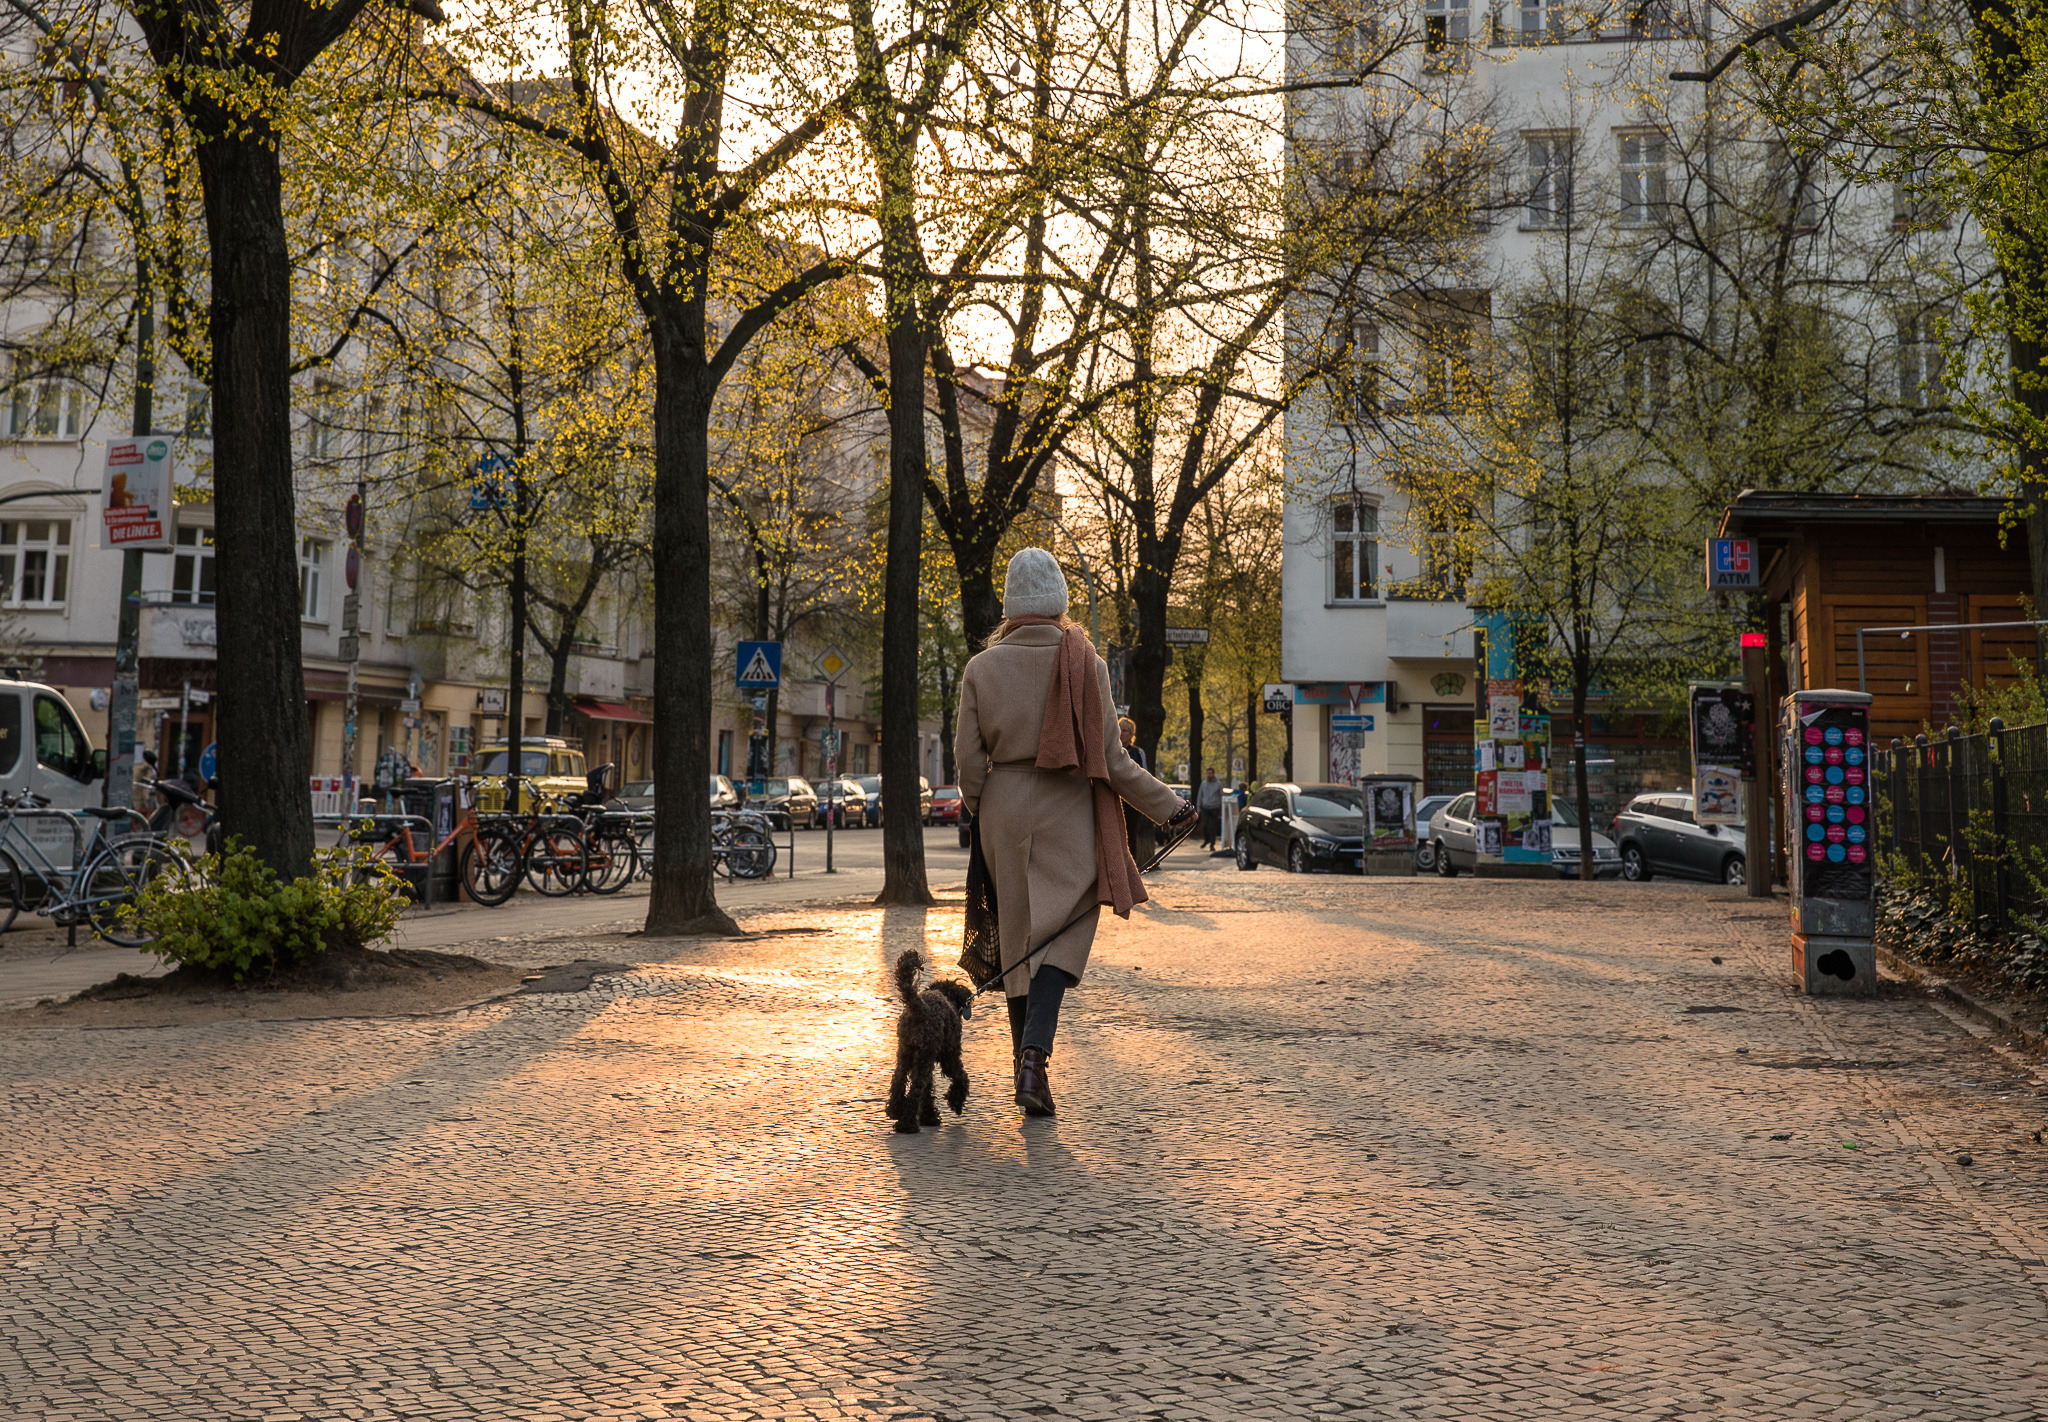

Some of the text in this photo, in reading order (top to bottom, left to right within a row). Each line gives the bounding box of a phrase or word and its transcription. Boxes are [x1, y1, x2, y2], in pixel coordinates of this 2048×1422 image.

[112, 527, 126, 540] DIE
[1717, 573, 1750, 585] ATM
[1266, 700, 1290, 711] OBC
